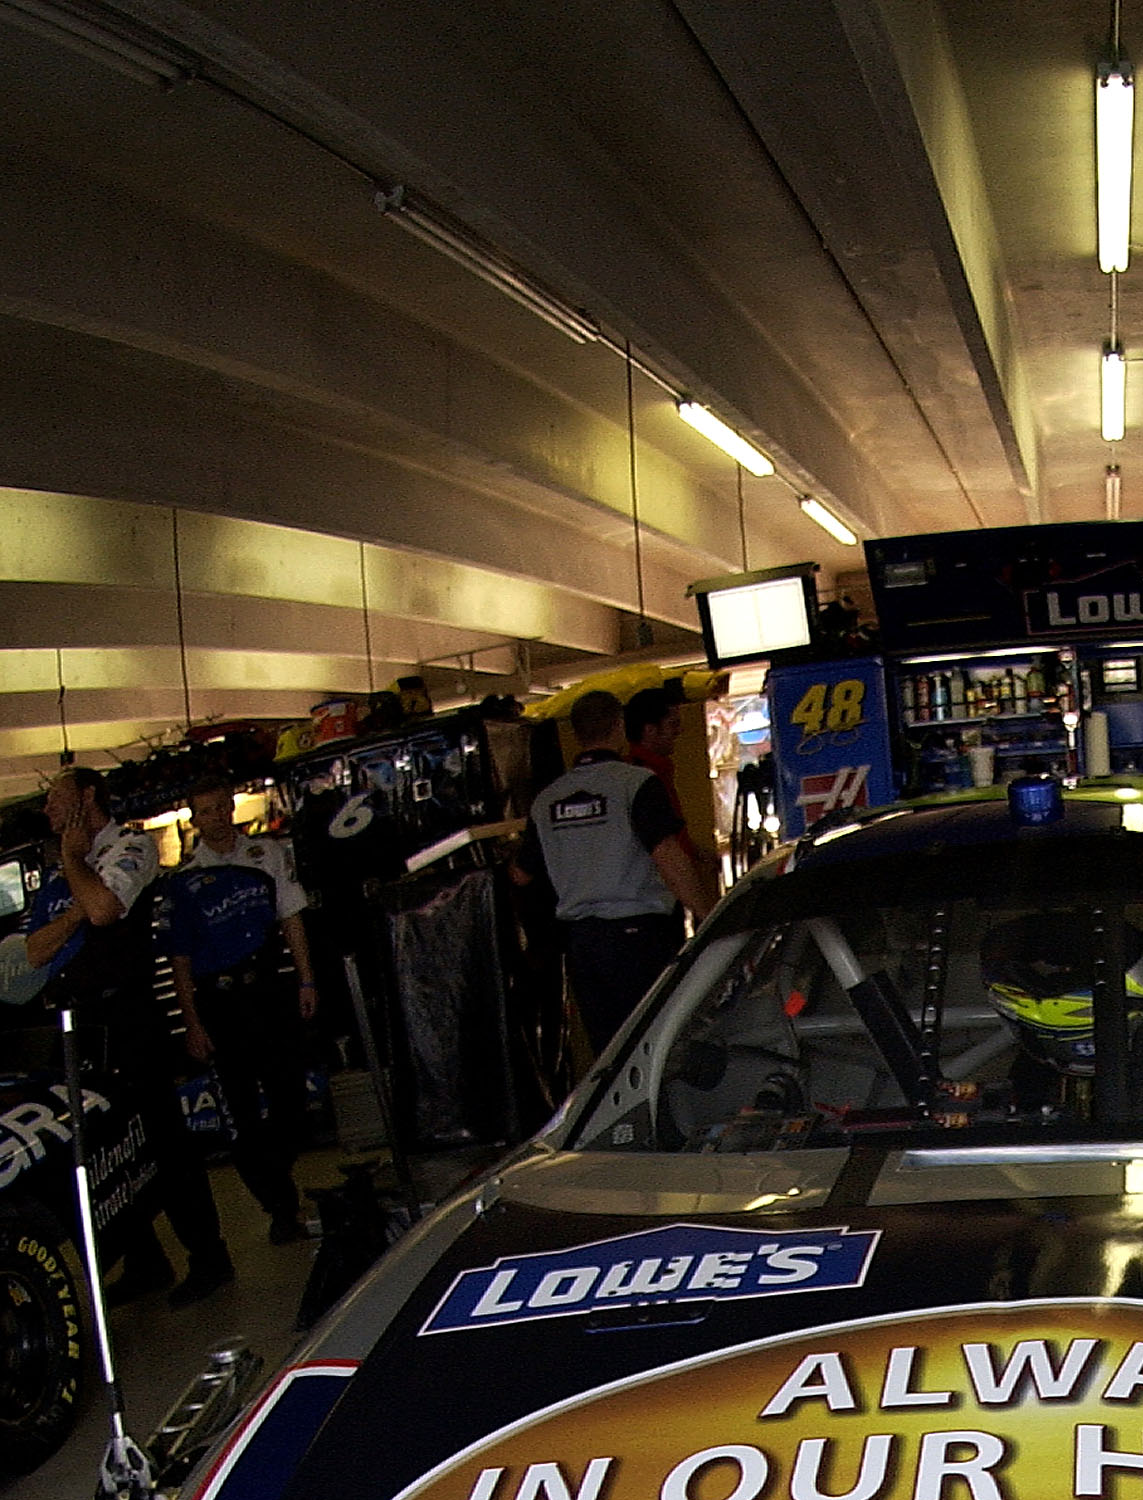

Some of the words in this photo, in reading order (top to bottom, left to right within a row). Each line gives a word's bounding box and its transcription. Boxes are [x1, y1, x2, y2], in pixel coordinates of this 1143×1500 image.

[790, 679, 866, 736] 48
[327, 792, 374, 840] 6
[471, 1242, 827, 1317] LOWE'S
